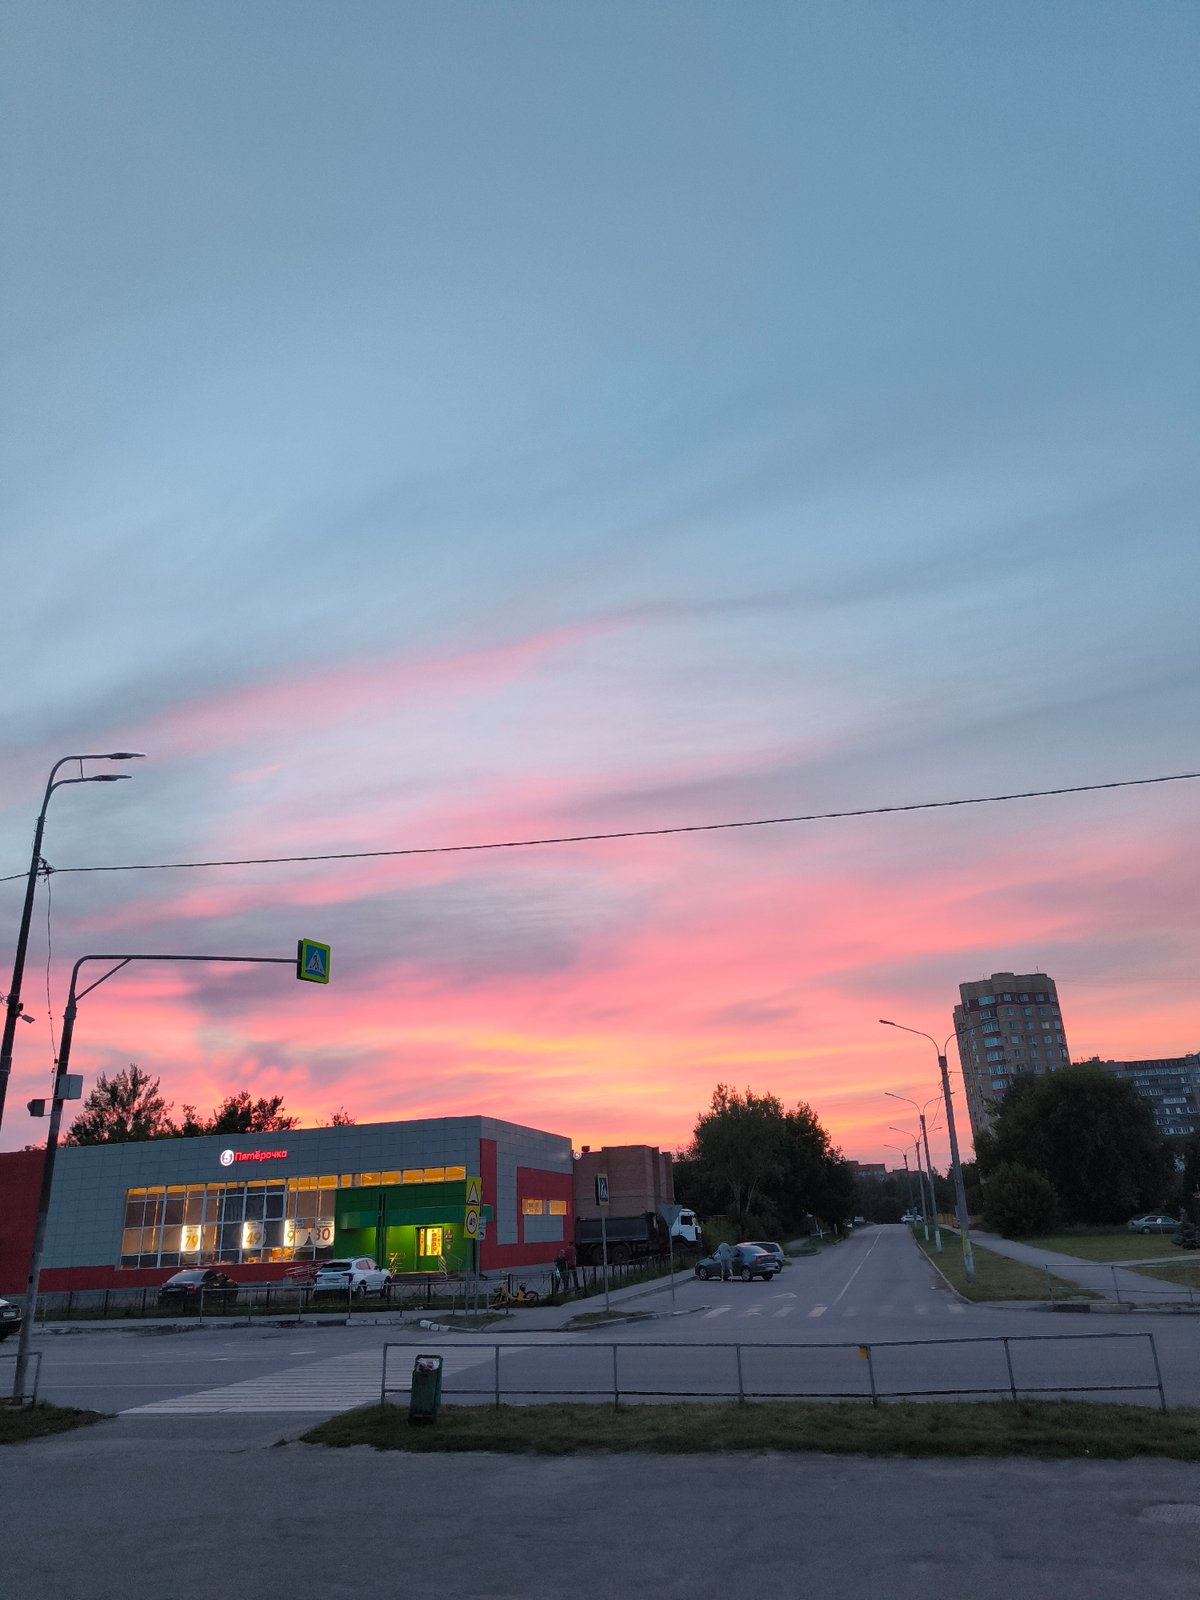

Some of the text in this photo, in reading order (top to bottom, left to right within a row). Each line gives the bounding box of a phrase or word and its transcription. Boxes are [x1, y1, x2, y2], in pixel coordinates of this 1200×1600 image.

[235, 1150, 288, 1162] Пятёрочка
[185, 1234, 199, 1248] 79
[246, 1232, 261, 1244] 49
